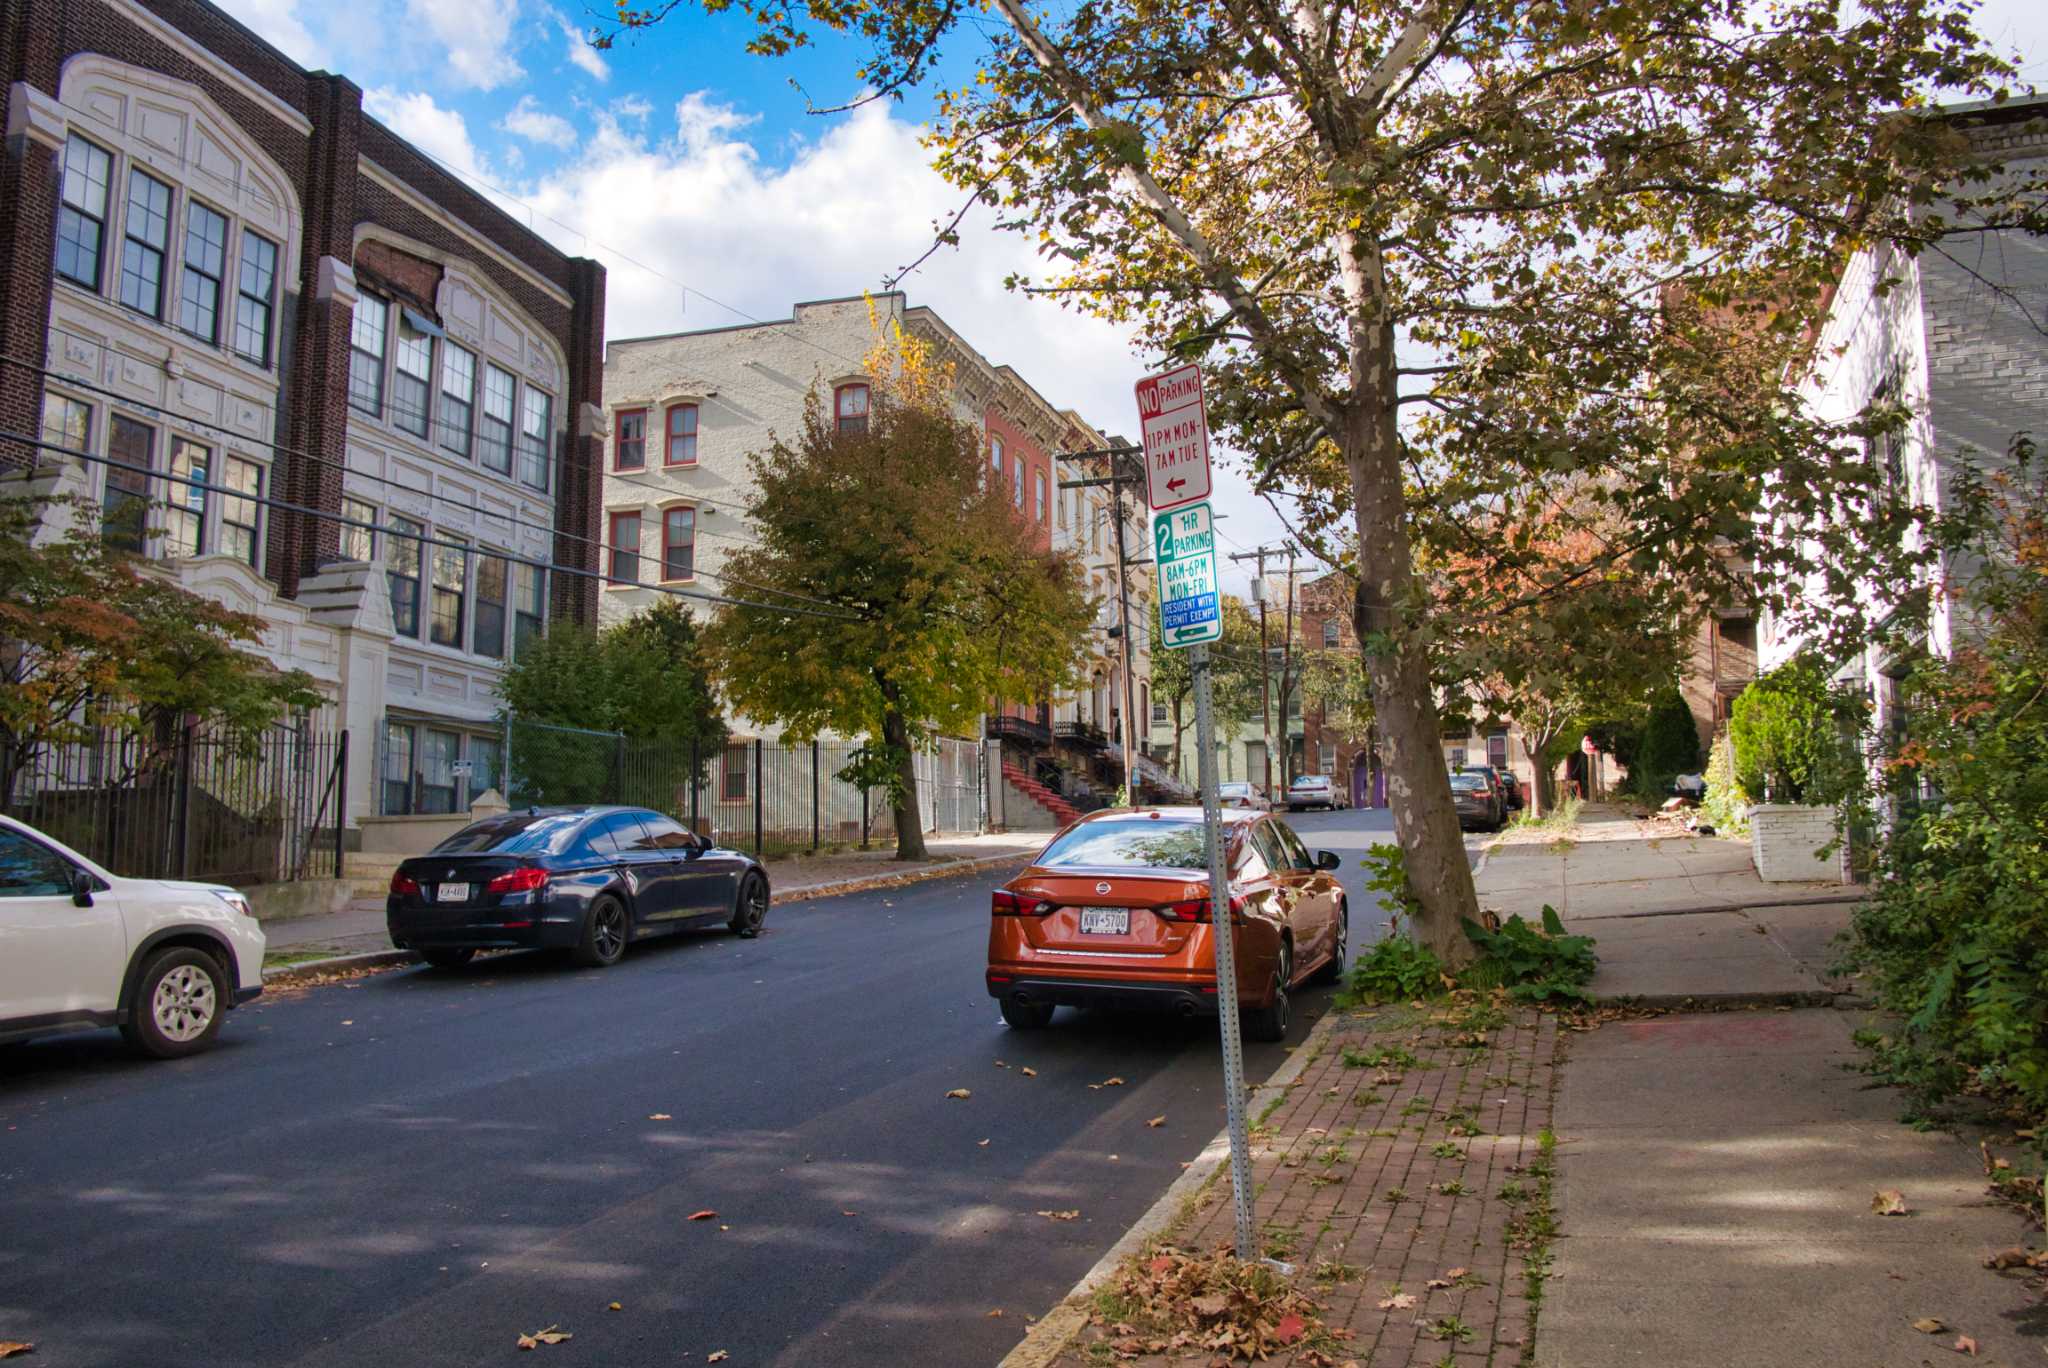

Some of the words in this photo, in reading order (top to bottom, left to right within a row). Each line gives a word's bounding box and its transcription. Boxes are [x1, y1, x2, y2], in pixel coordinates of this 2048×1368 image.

[1139, 387, 1159, 415] NO
[1160, 376, 1199, 403] PARKING
[1147, 431, 1172, 449] 11PM
[1155, 450, 1176, 471] 7AM
[1178, 443, 1198, 463] TUE
[1158, 524, 1172, 557] 2
[1183, 512, 1199, 531] HR
[1174, 530, 1211, 555] PARKING
[1166, 558, 1207, 582] 8AM-6PM
[1169, 578, 1207, 600] MON-FRI
[1164, 598, 1196, 615] RESIDENT
[1197, 594, 1215, 608] WITH
[1165, 612, 1188, 627] PERMIT
[1190, 607, 1216, 622] EXEMPT
